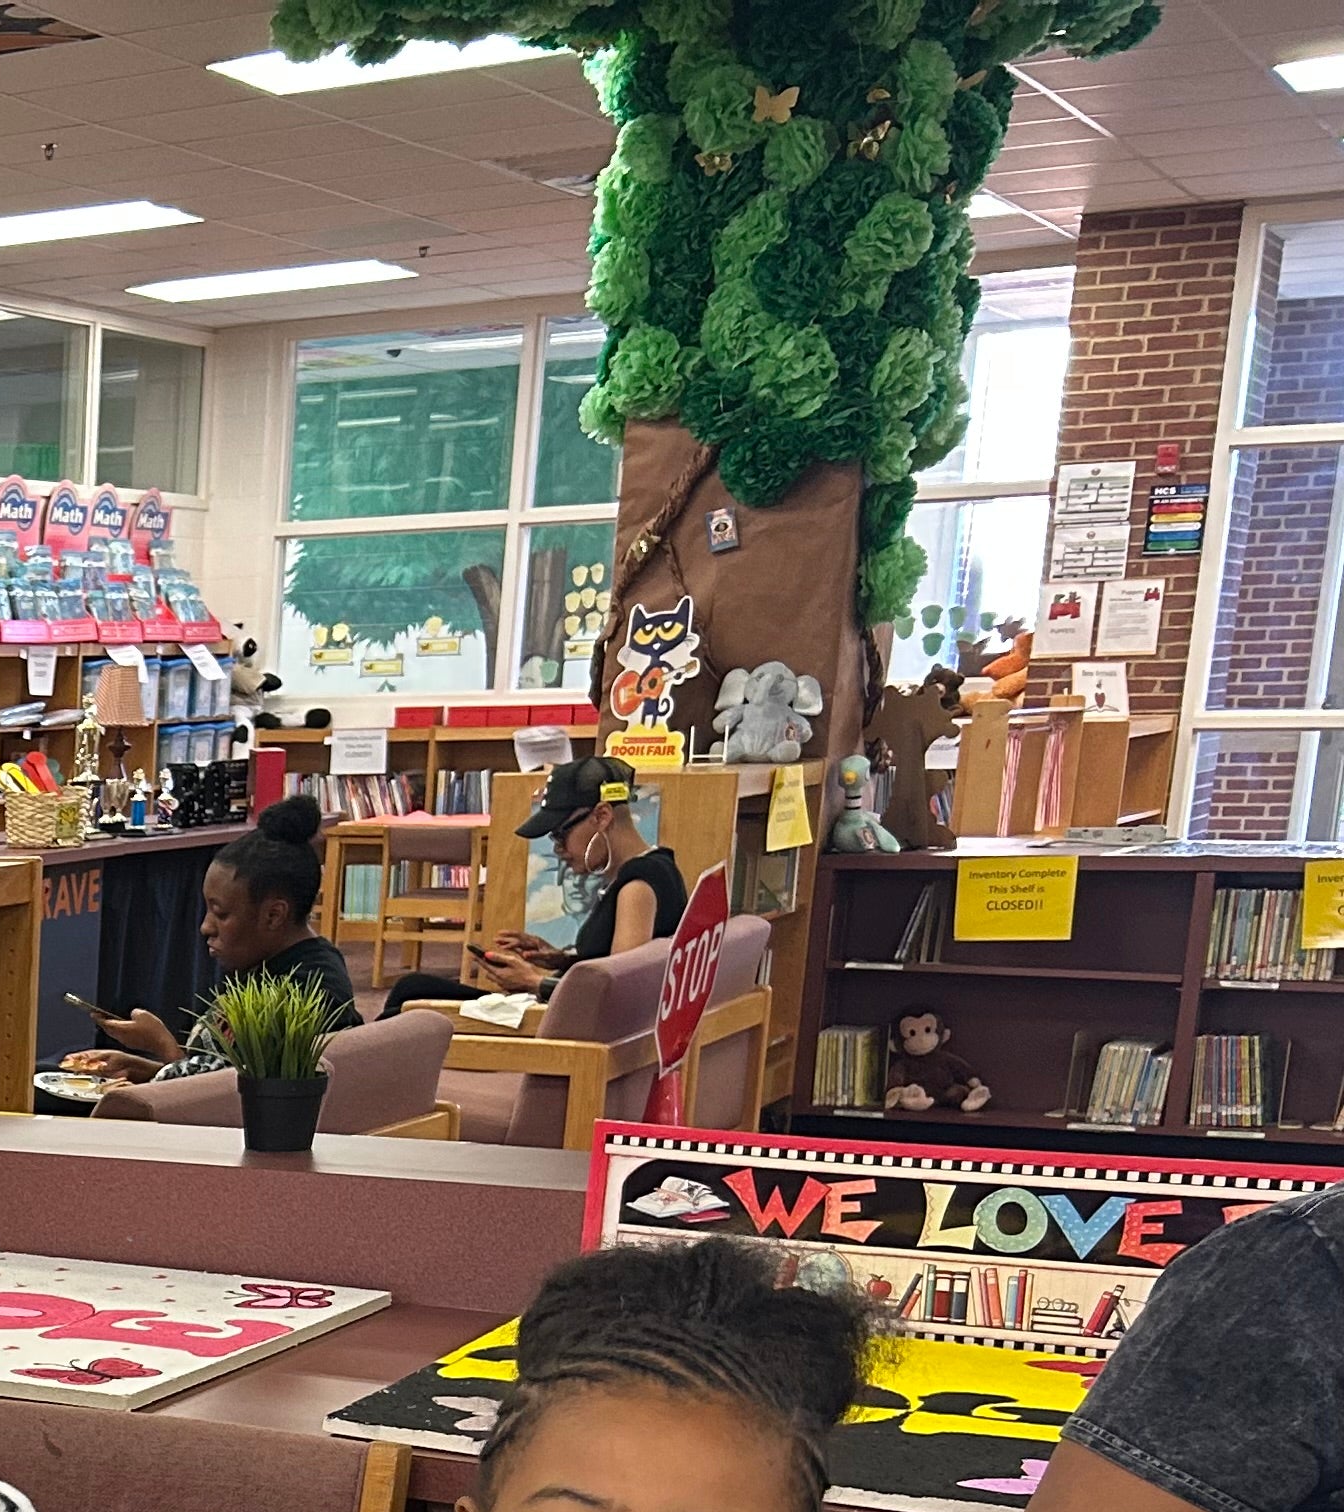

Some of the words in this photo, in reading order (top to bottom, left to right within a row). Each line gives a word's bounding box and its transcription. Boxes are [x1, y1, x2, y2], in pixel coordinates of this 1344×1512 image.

[51, 504, 85, 524] Math
[93, 508, 124, 527] Math
[136, 511, 166, 530] Math
[646, 745, 675, 756] FAIR
[969, 870, 1017, 879] Inventory
[1019, 868, 1067, 879] Complete
[988, 885, 1007, 894] This
[1010, 884, 1035, 894] Shelf
[1037, 885, 1045, 893] is
[661, 921, 724, 1021] STOP
[722, 1167, 884, 1243] WE
[916, 1182, 1190, 1267] LOVE
